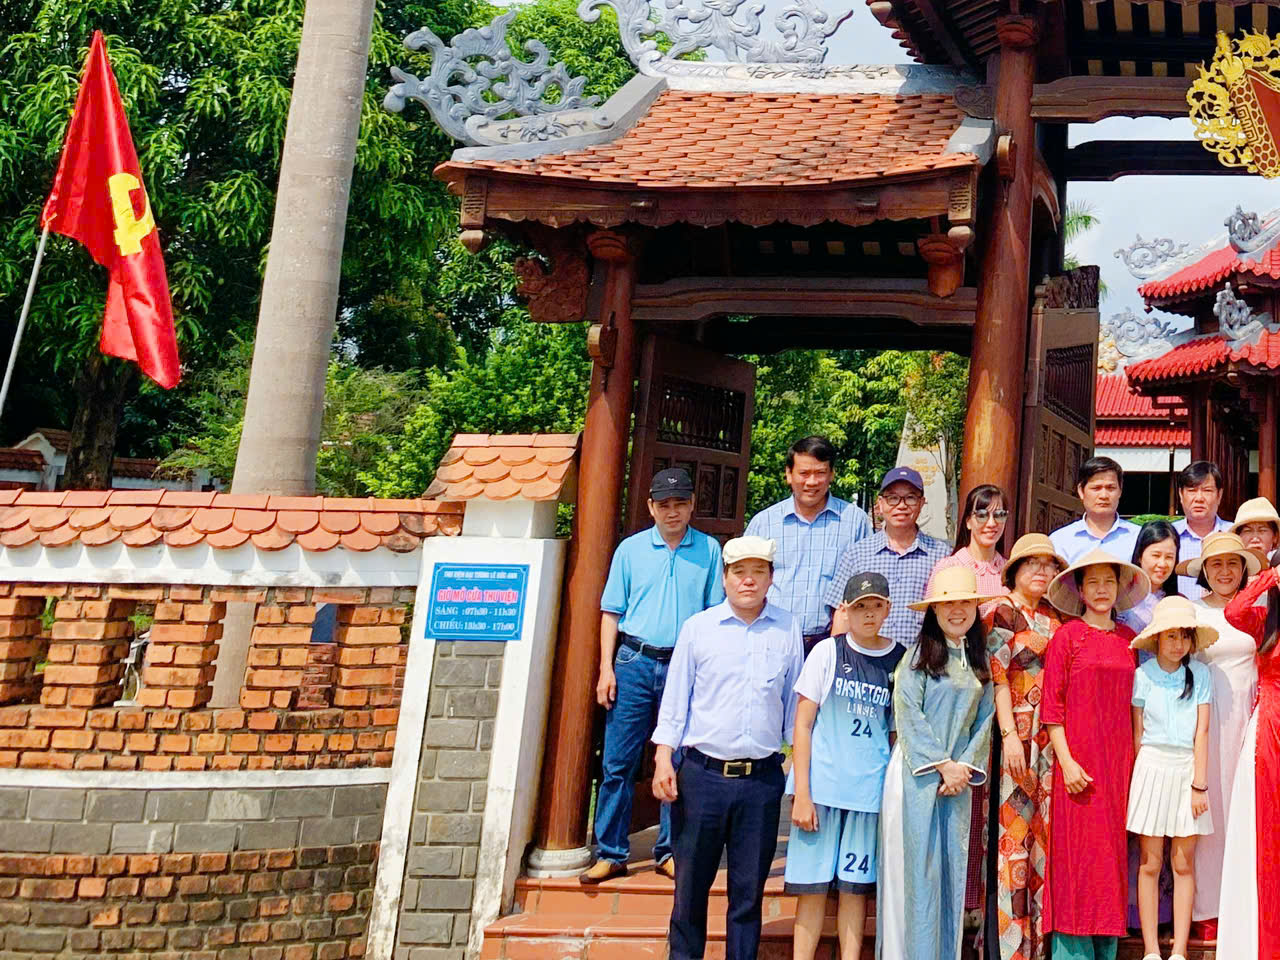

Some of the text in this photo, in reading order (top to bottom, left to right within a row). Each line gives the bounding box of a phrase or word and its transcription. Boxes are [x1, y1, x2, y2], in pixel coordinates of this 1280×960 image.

[499, 588, 519, 605] VIỆN
[851, 718, 873, 738] 24
[843, 852, 869, 874] 24
